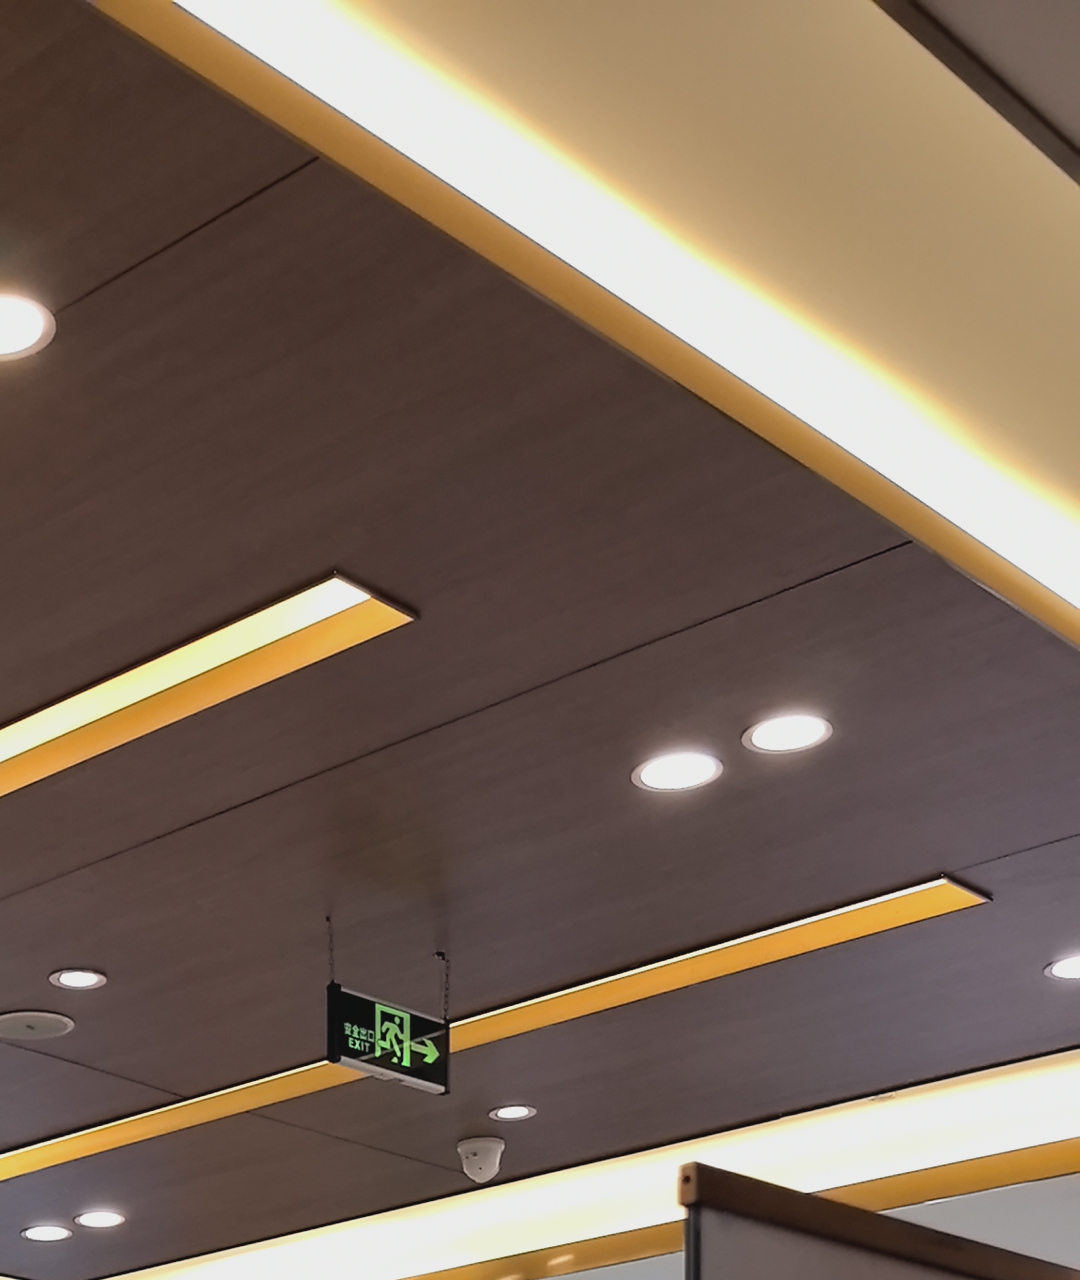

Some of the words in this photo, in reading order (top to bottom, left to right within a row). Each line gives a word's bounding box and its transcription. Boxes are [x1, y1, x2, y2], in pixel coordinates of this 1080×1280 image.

[343, 1022, 375, 1043] 安全出口
[348, 1037, 371, 1052] EXIT
